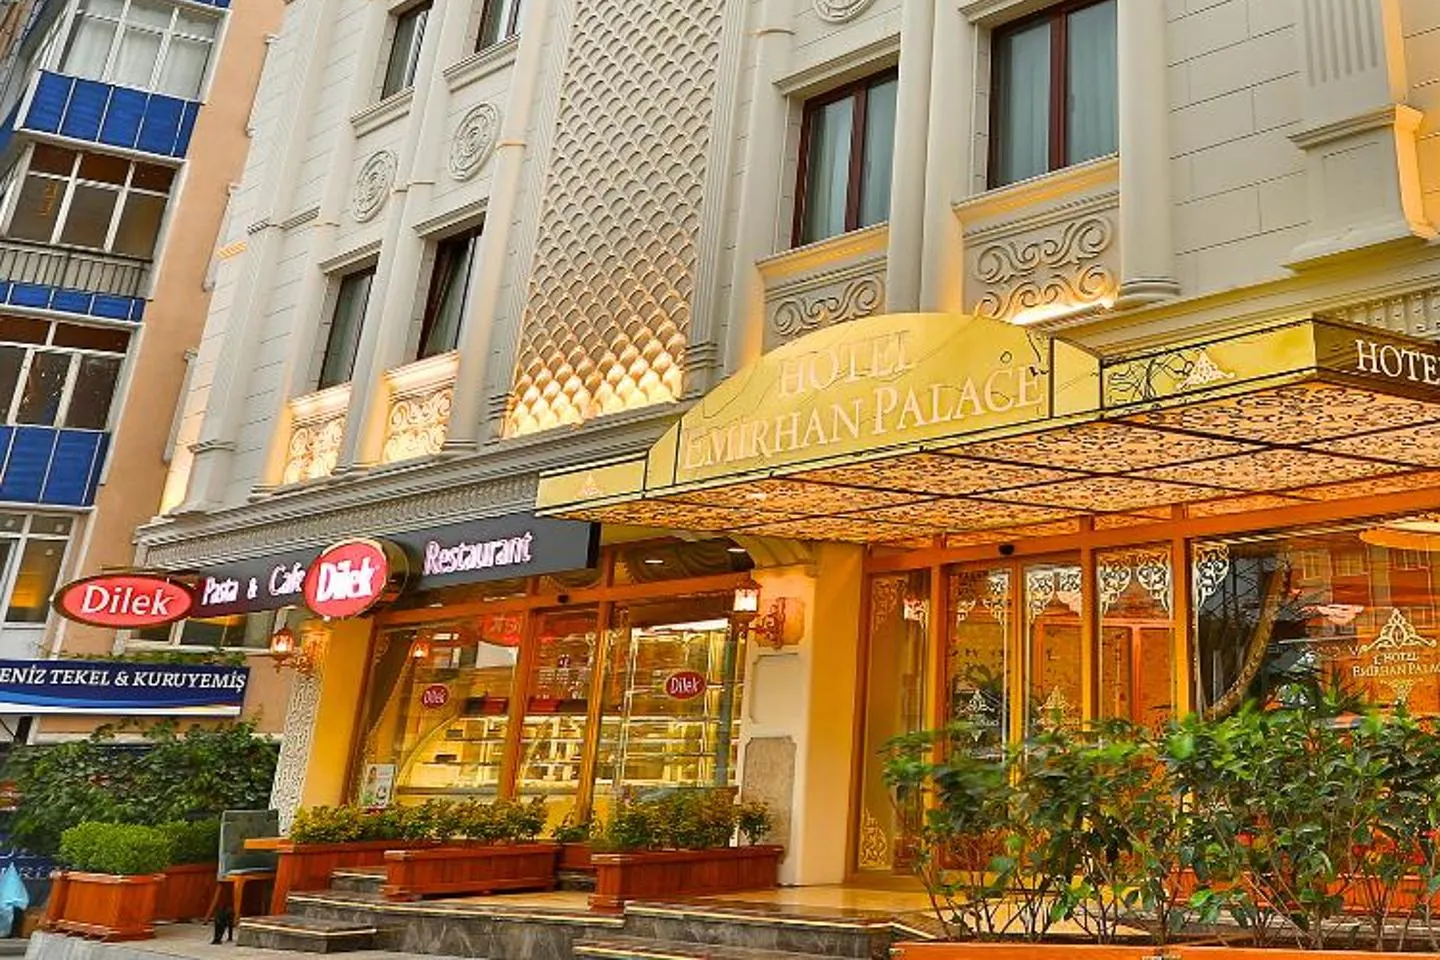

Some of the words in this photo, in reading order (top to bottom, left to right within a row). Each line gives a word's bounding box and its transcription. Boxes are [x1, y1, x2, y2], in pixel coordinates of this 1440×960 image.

[779, 330, 916, 397] HOTEL
[682, 397, 864, 469] EMIRHAN
[873, 365, 1044, 436] PALACE
[424, 531, 533, 576] Restaurant
[201, 575, 239, 606] Pasta
[316, 554, 375, 602] Dilek
[81, 583, 174, 616] Dilek
[50, 669, 110, 686] TEKEL
[113, 671, 129, 687] &
[132, 671, 246, 693] KURUYEMİŞ
[670, 676, 701, 694] Dilek
